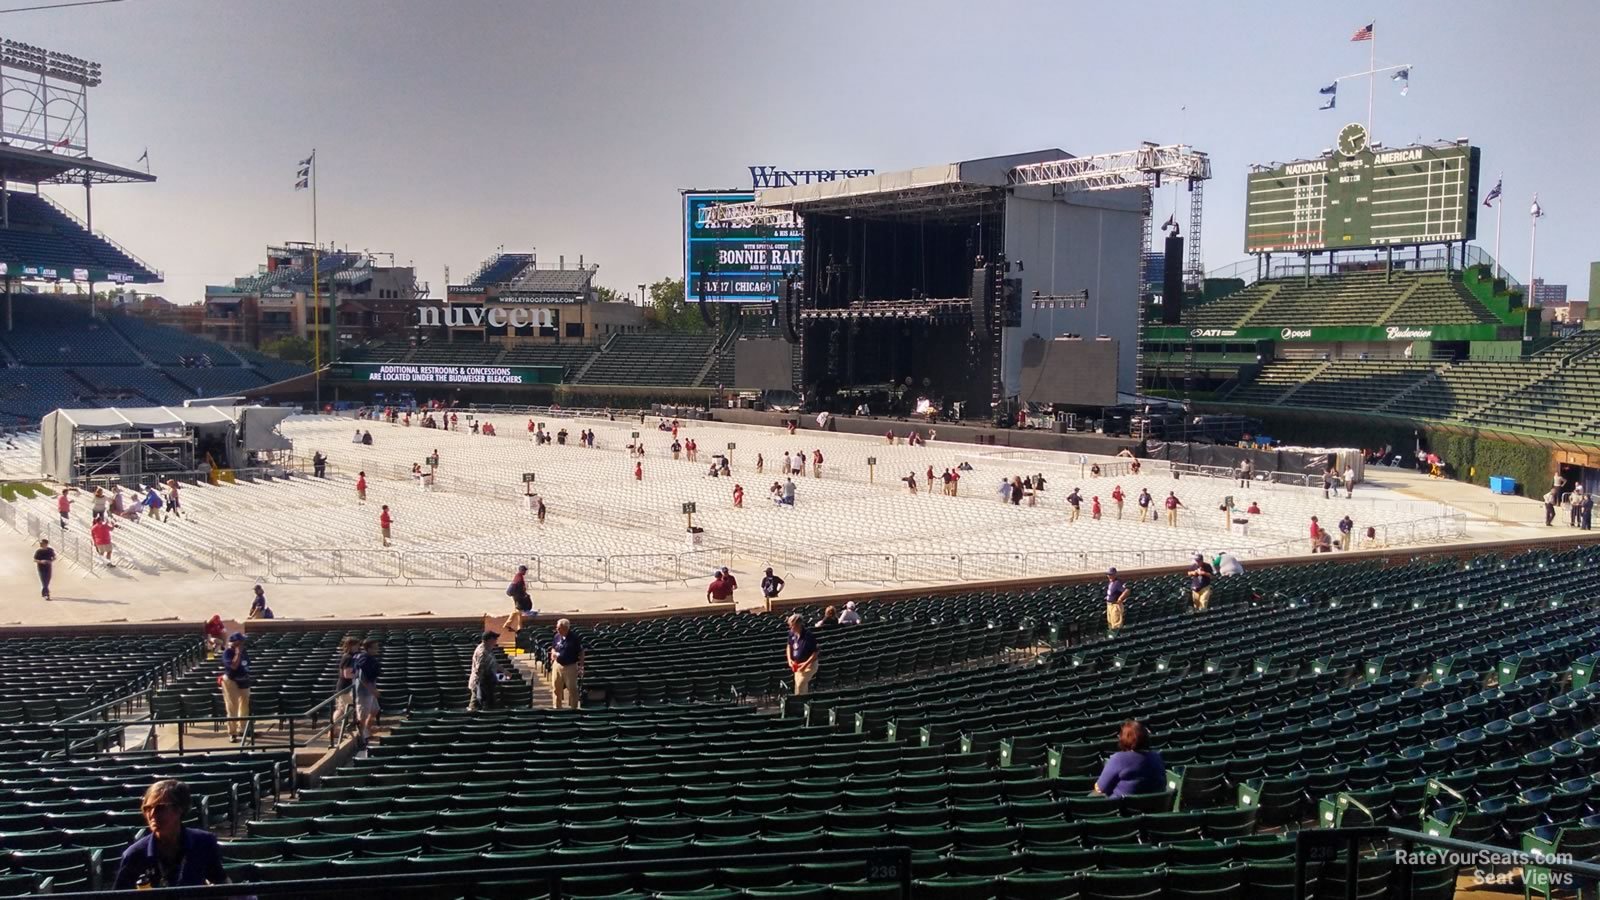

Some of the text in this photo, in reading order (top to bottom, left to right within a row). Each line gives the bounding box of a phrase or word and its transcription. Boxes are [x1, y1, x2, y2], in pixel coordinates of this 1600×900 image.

[1374, 150, 1422, 164] AMERICAN
[1286, 161, 1328, 175] NATIONAL
[719, 250, 767, 264] BONNIE
[720, 282, 729, 292] 17
[735, 282, 772, 292] CHICAGO
[418, 306, 553, 328] nuveen
[1291, 329, 1311, 338] pepsi
[1386, 326, 1432, 339] Budweiser
[466, 368, 510, 376] CONCESSIONS
[871, 866, 897, 878] 236
